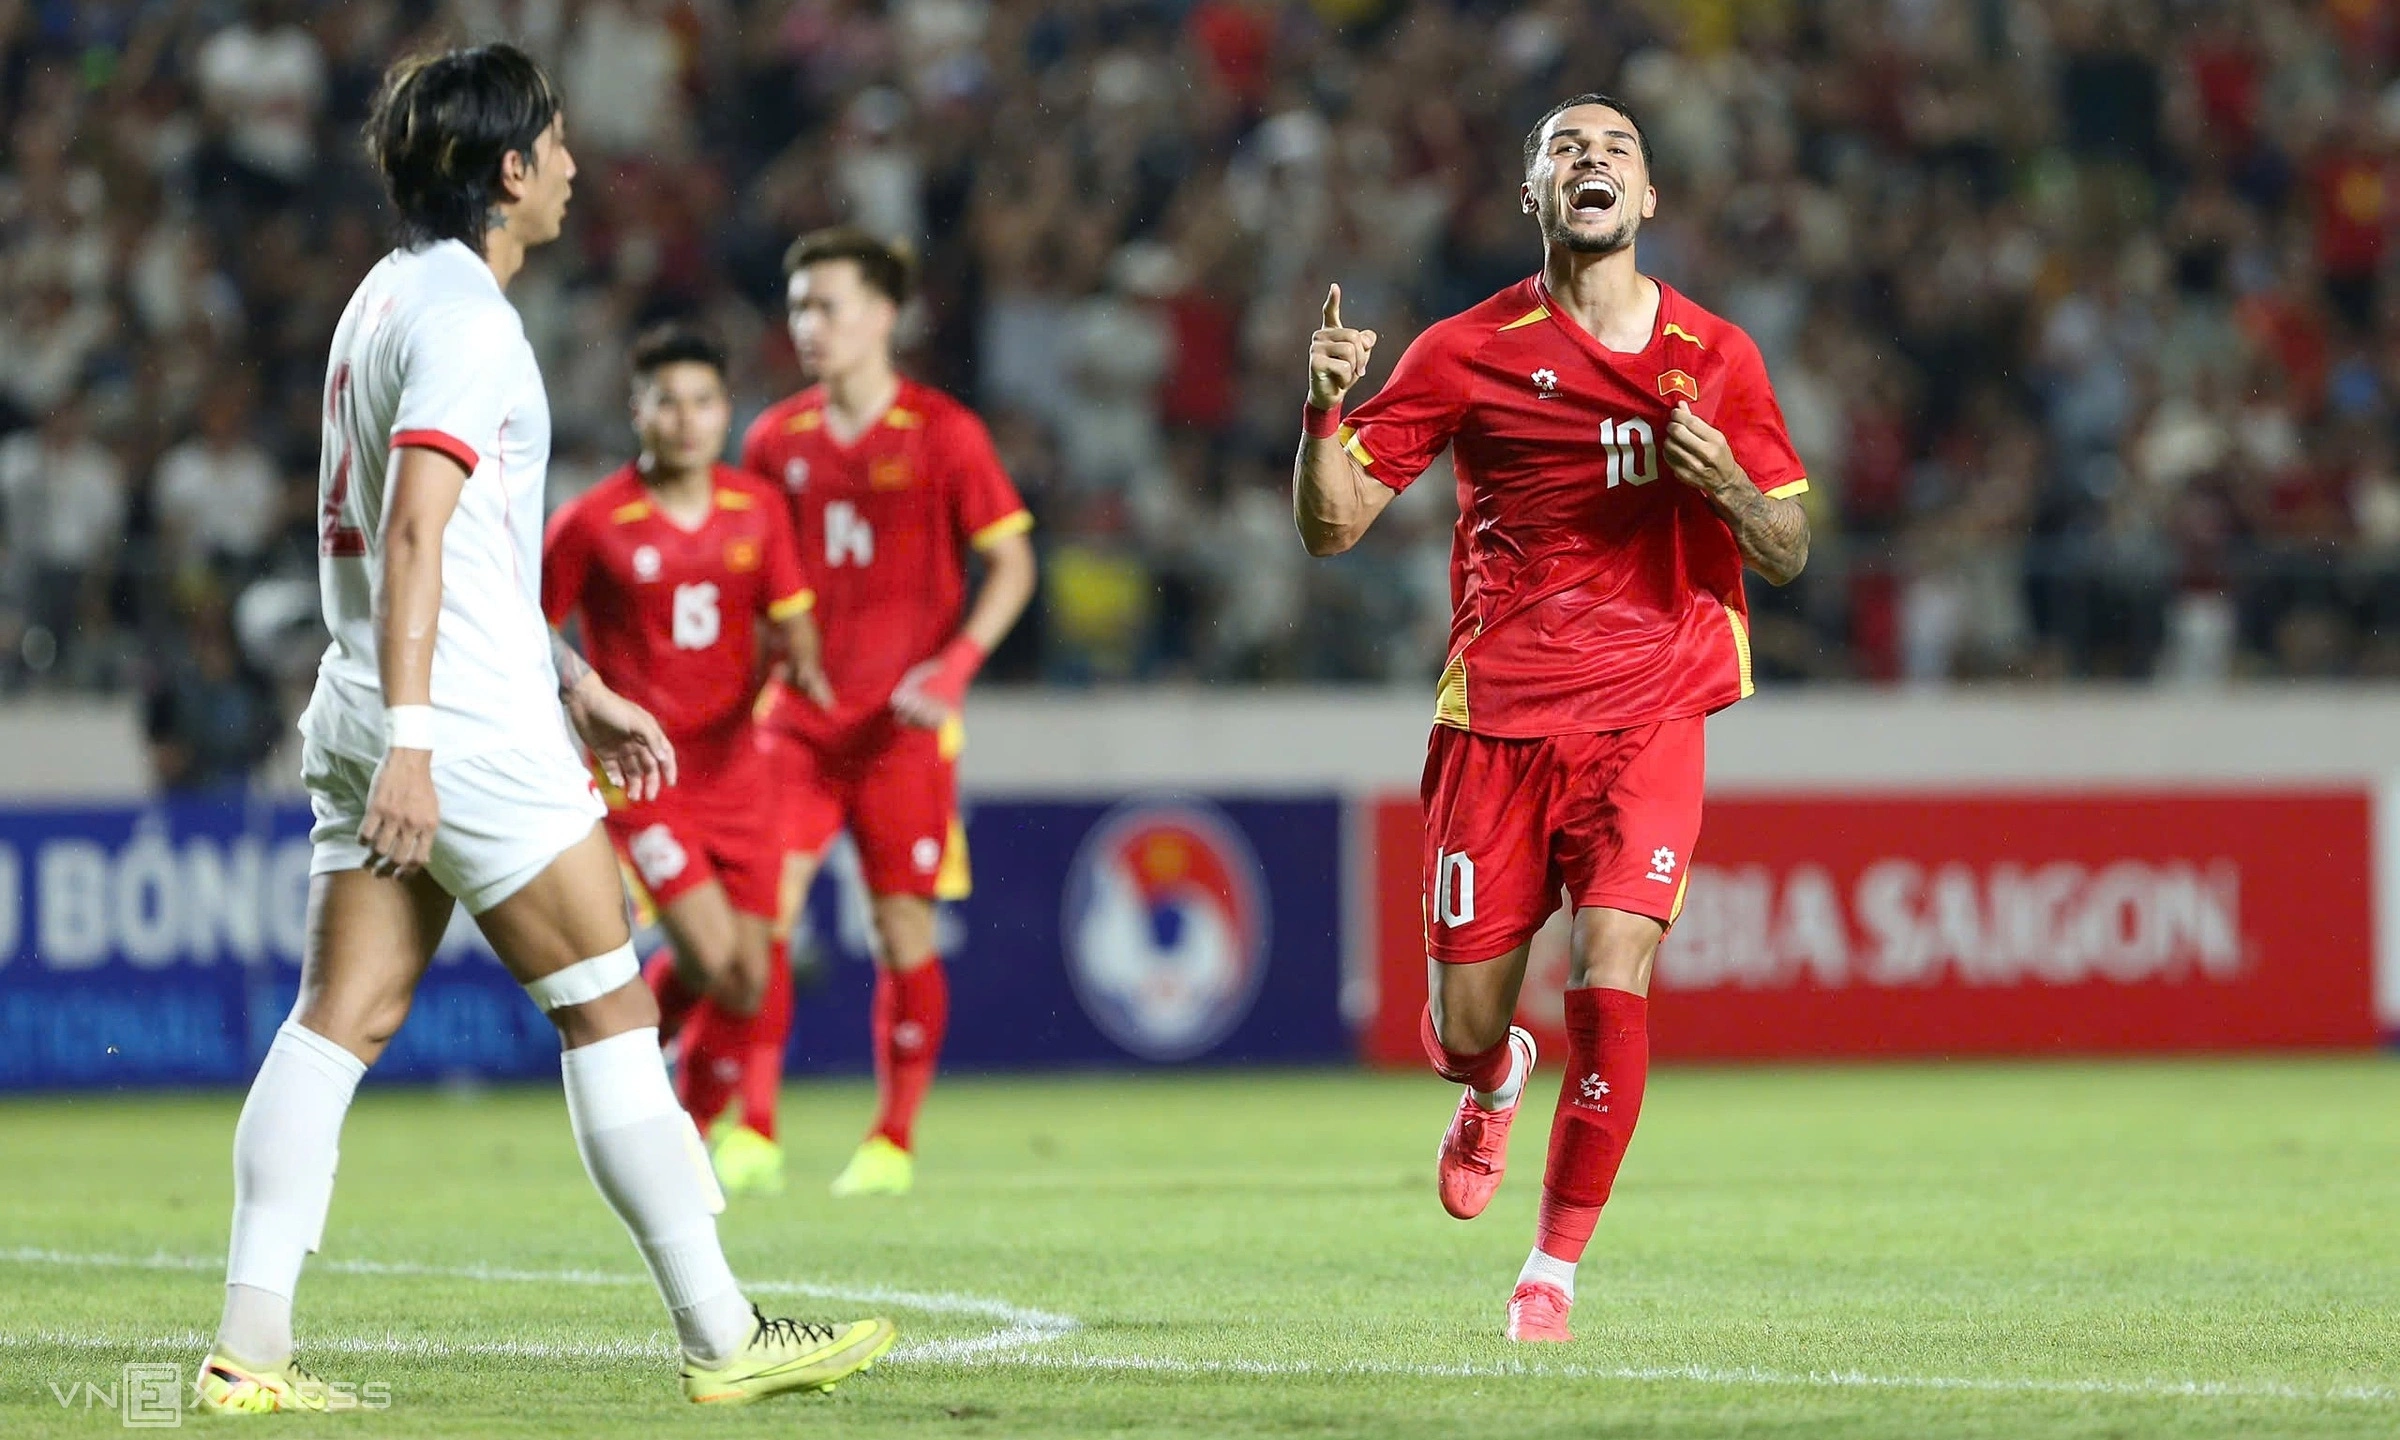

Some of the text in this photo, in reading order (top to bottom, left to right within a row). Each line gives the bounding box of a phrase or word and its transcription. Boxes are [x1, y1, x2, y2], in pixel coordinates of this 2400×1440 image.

[1599, 416, 1660, 490] 10
[824, 501, 874, 568] 14
[673, 581, 721, 650] 15
[1433, 845, 1475, 928] 10
[1854, 858, 2245, 985] SAIGON
